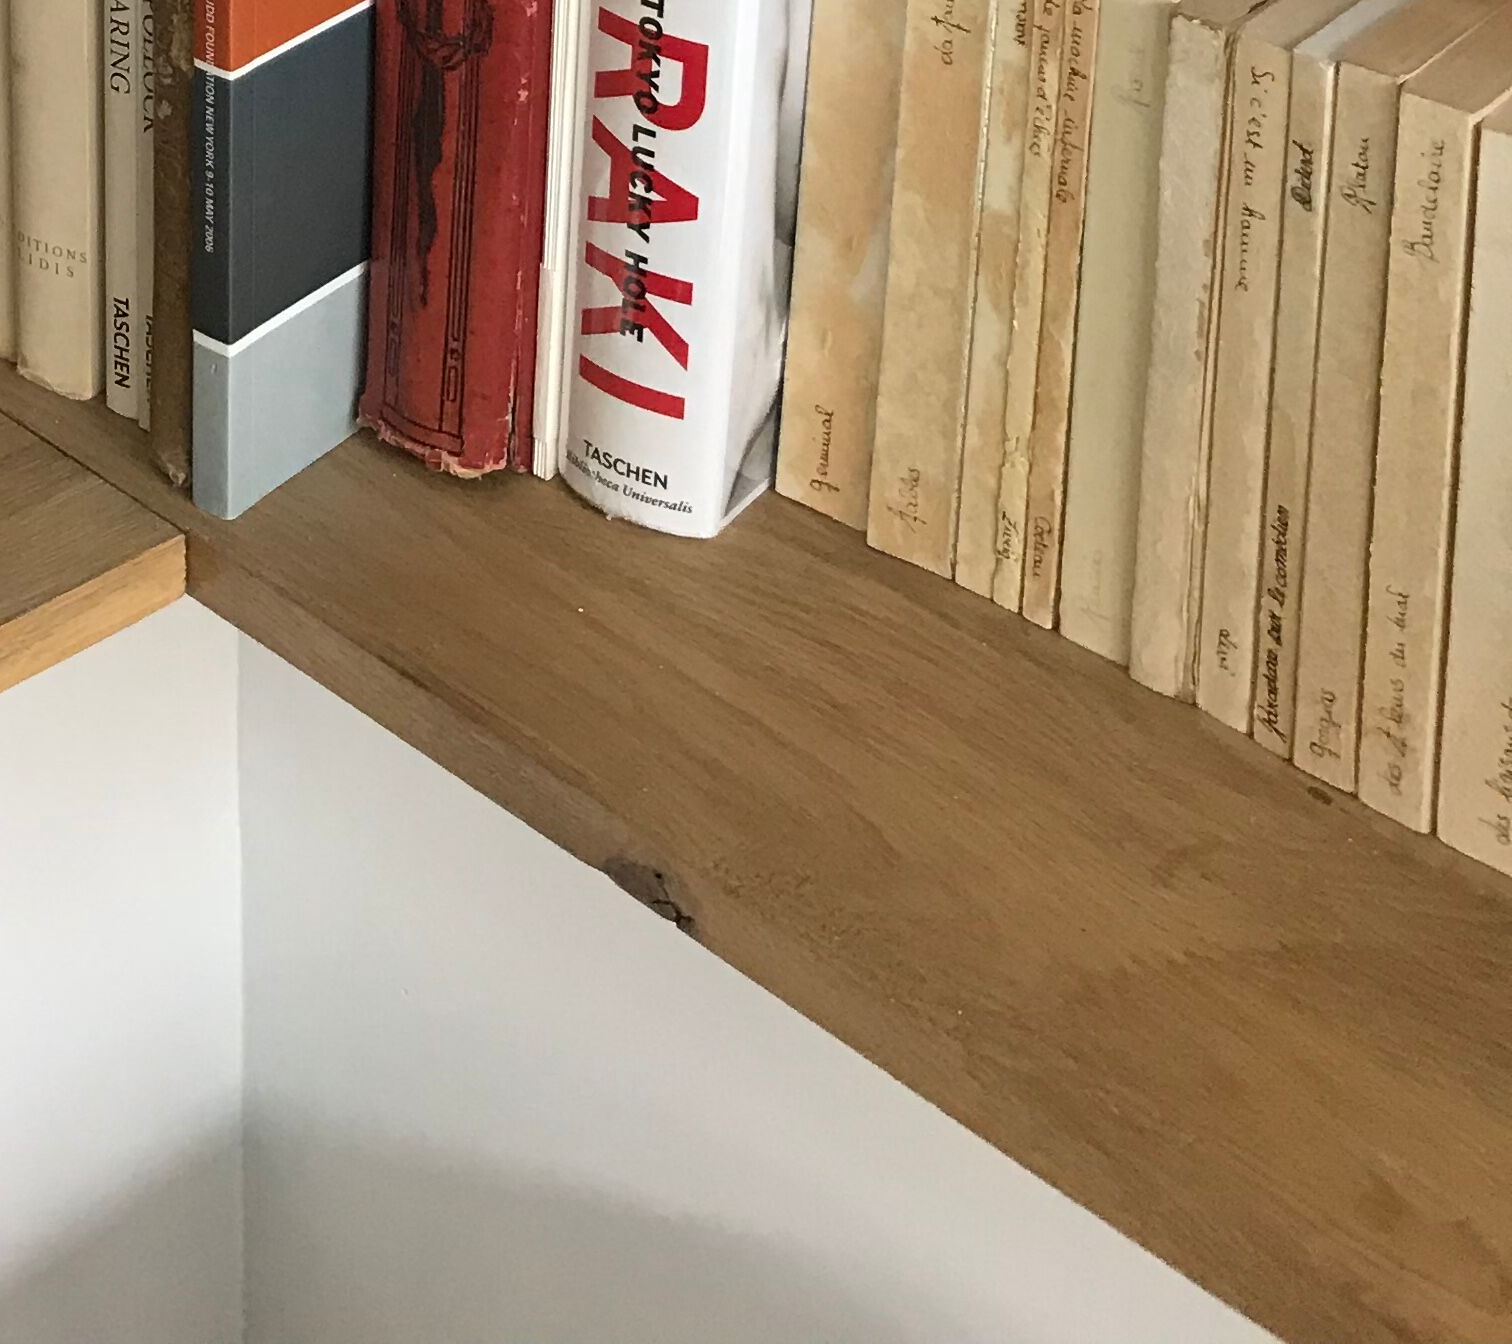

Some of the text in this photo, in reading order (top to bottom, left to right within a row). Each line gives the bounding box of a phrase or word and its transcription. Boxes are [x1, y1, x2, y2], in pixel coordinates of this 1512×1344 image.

[204, 105, 215, 135] NEW
[1245, 96, 1268, 149] c'est
[204, 136, 215, 168] YORK
[1242, 157, 1255, 186] un
[1338, 137, 1376, 214] Platon
[204, 170, 215, 197] 9-10
[626, 125, 659, 243] LUCKY
[1402, 139, 1445, 263] Baudelaire
[204, 198, 215, 224] MAY
[1235, 201, 1266, 292] homme
[619, 248, 650, 345] HOLE
[113, 296, 131, 390] TASCHEN
[583, 439, 669, 490] TASCHEN
[622, 484, 694, 515] Universalis
[1031, 516, 1052, 578] Cocteau
[1266, 610, 1284, 647] sur
[1386, 641, 1408, 668] du
